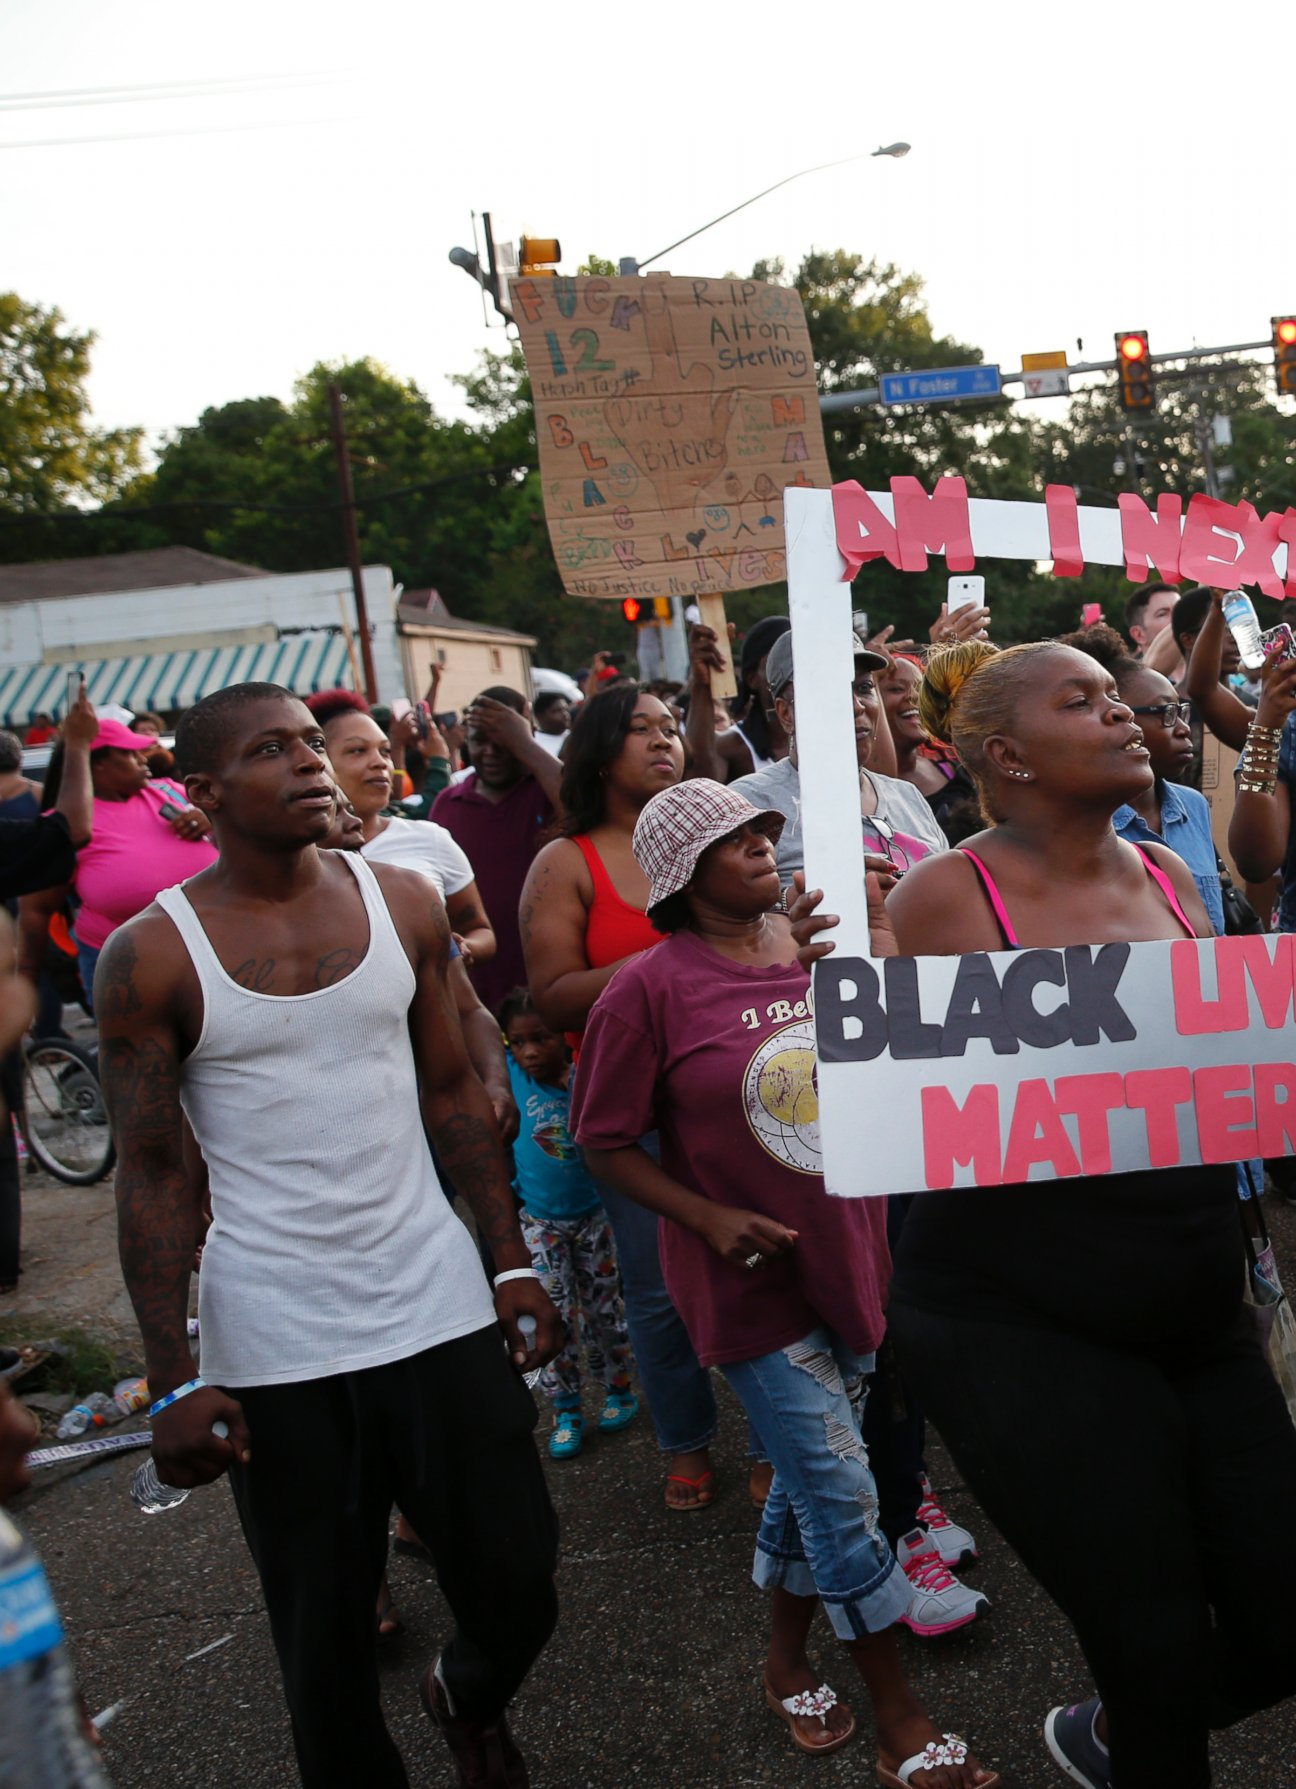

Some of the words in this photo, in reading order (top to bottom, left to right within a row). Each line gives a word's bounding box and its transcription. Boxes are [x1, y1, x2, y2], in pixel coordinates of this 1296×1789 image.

[513, 278, 642, 332] FUCK
[710, 315, 791, 345] Alton
[543, 327, 617, 378] 12
[718, 345, 809, 378] Sterling
[889, 380, 904, 397] N
[831, 476, 975, 582] AM
[1045, 484, 1084, 578] I
[741, 1007, 761, 1030] I
[815, 942, 1137, 1062] BLACK
